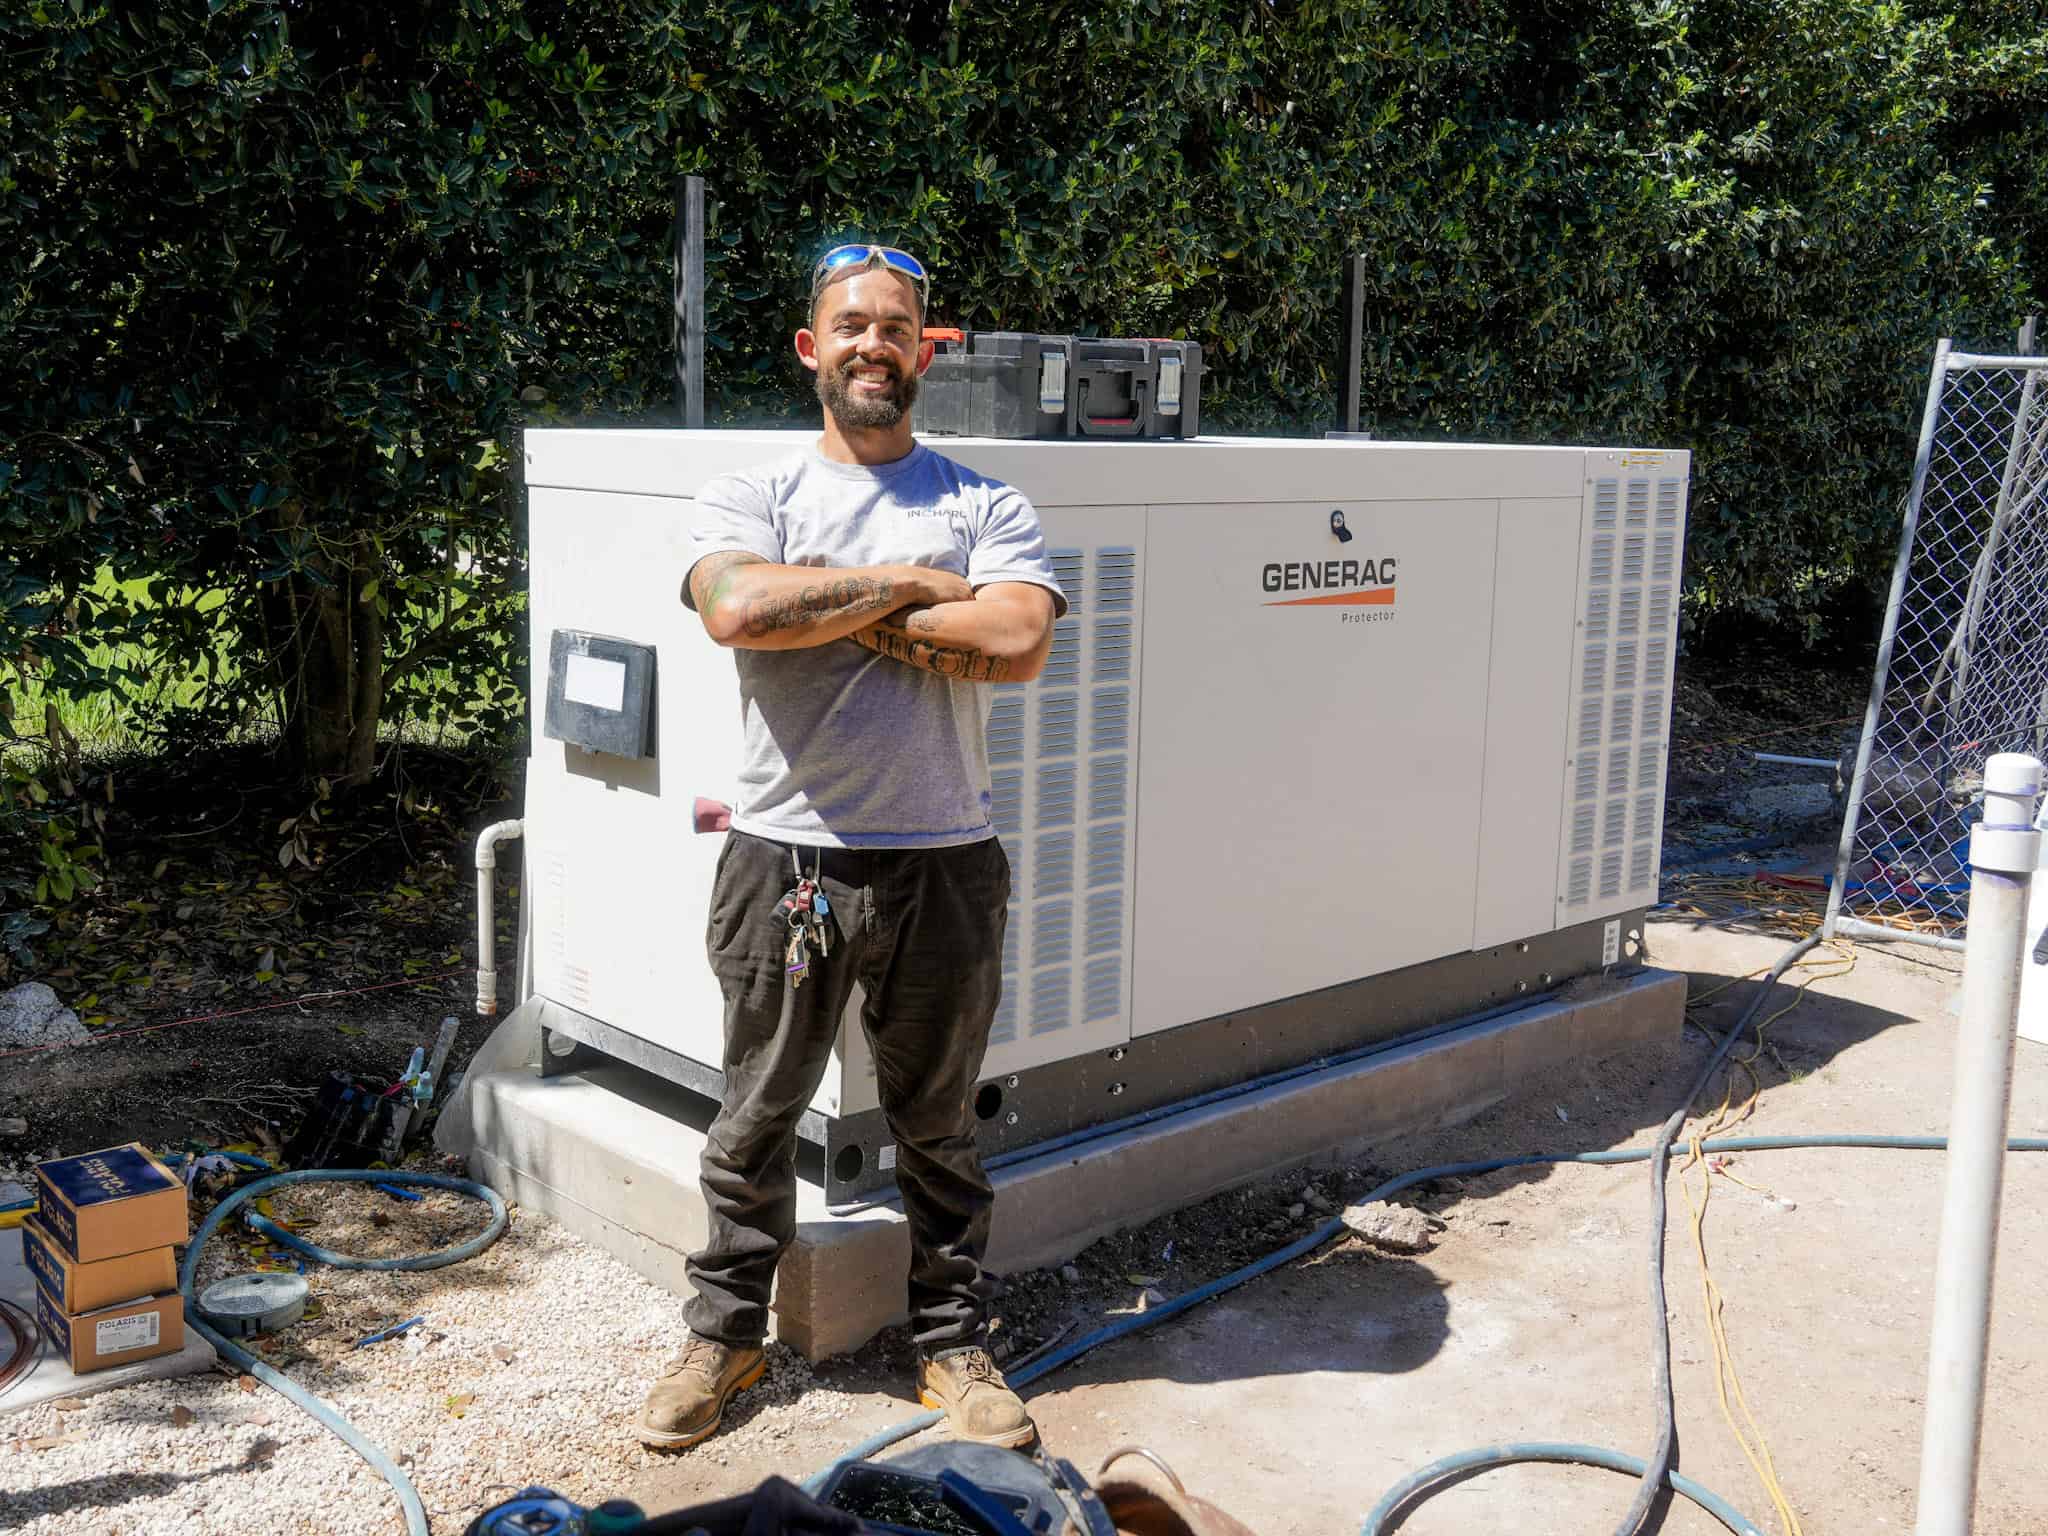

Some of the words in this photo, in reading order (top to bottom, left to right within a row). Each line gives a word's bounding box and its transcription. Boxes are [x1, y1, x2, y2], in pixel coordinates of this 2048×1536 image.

[1262, 558, 1396, 592] GENERAC
[1342, 611, 1395, 623] Protector
[98, 1316, 137, 1331] POLARIS
